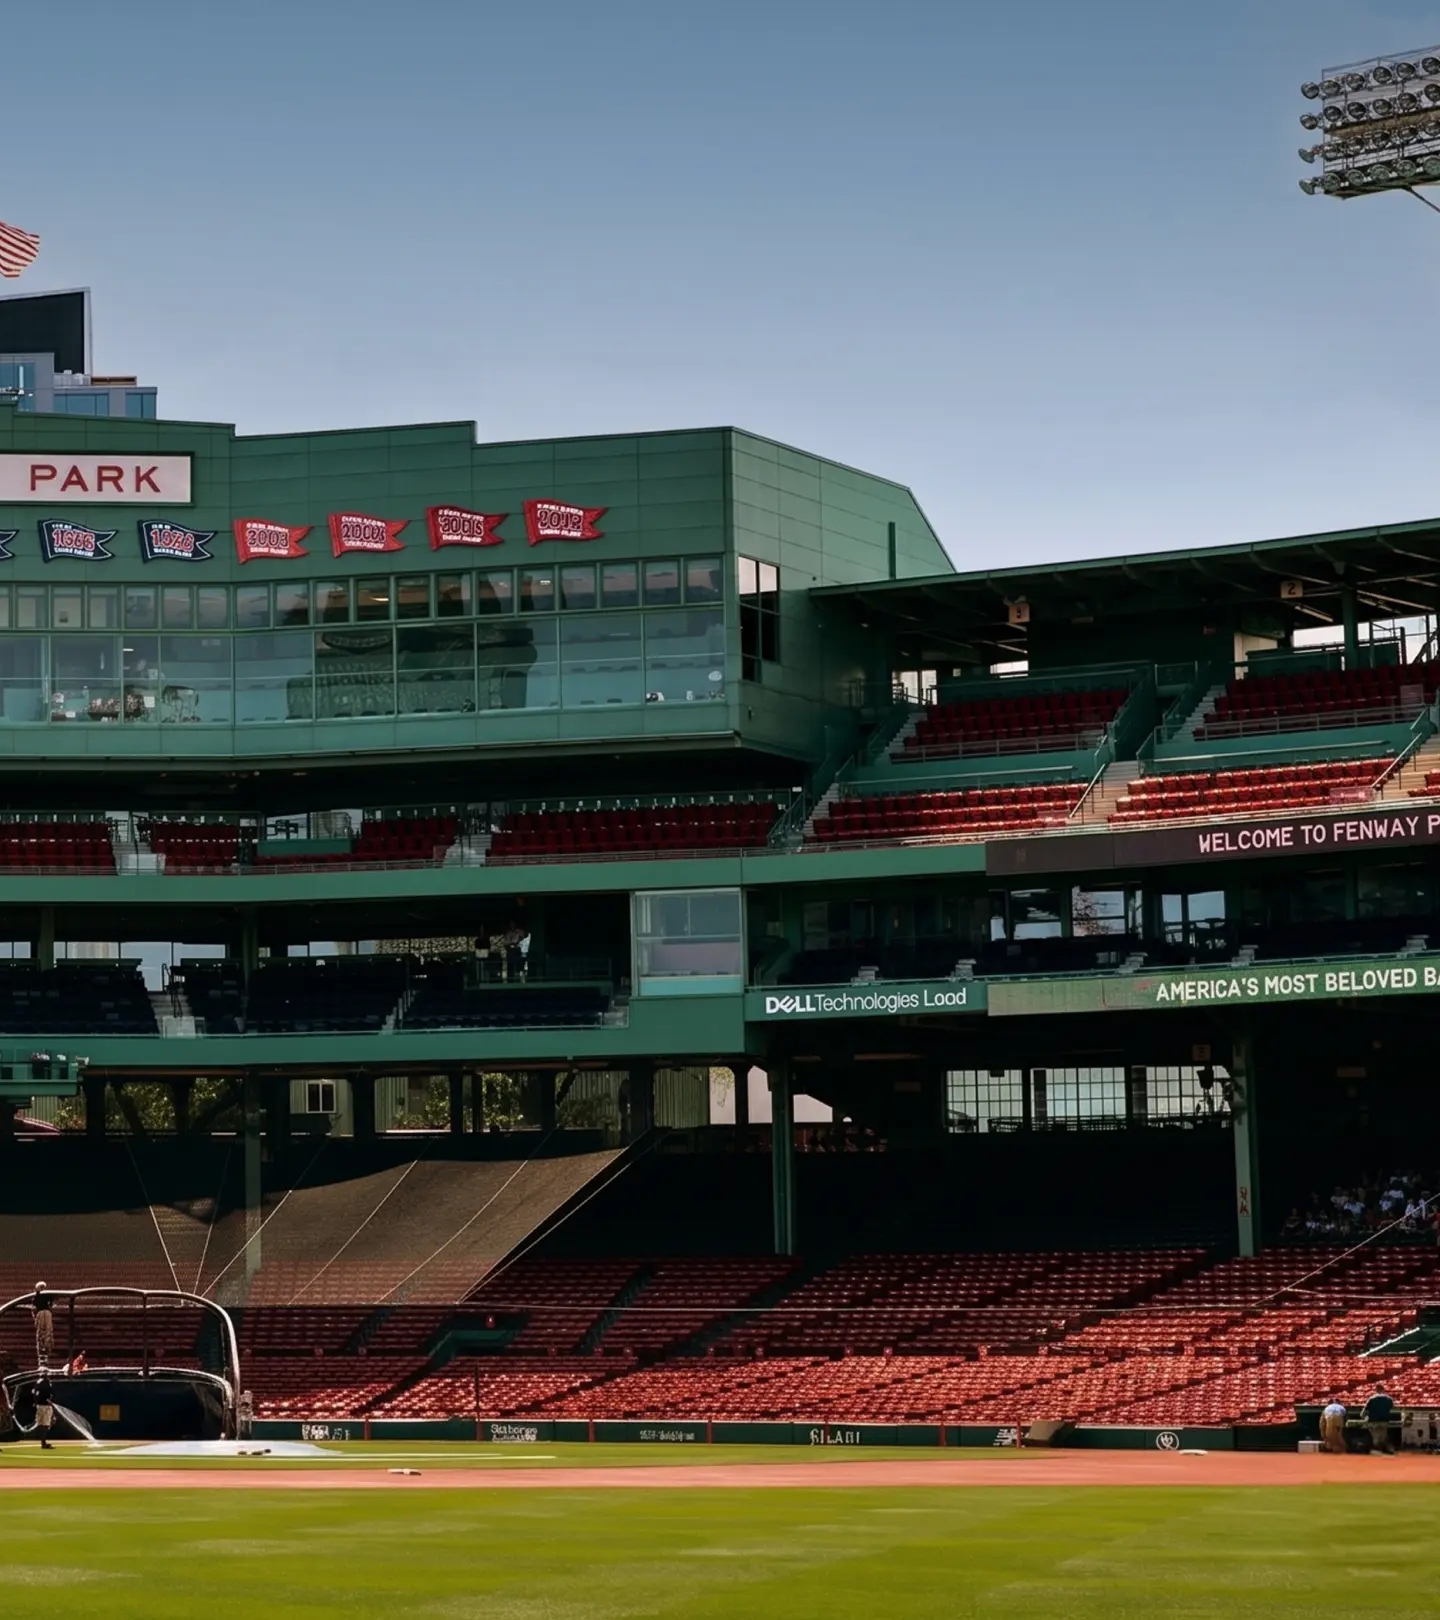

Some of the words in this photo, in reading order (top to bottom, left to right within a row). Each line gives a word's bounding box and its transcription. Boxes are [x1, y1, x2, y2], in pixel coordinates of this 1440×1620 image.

[29, 464, 161, 492] PARK
[1198, 826, 1294, 854] WELCOME
[1300, 824, 1326, 845] TO
[1333, 816, 1419, 843] FENWAY
[1156, 977, 1258, 1002] AMERICA'S
[1264, 973, 1319, 996] MOST
[1325, 967, 1417, 993] BELOVED
